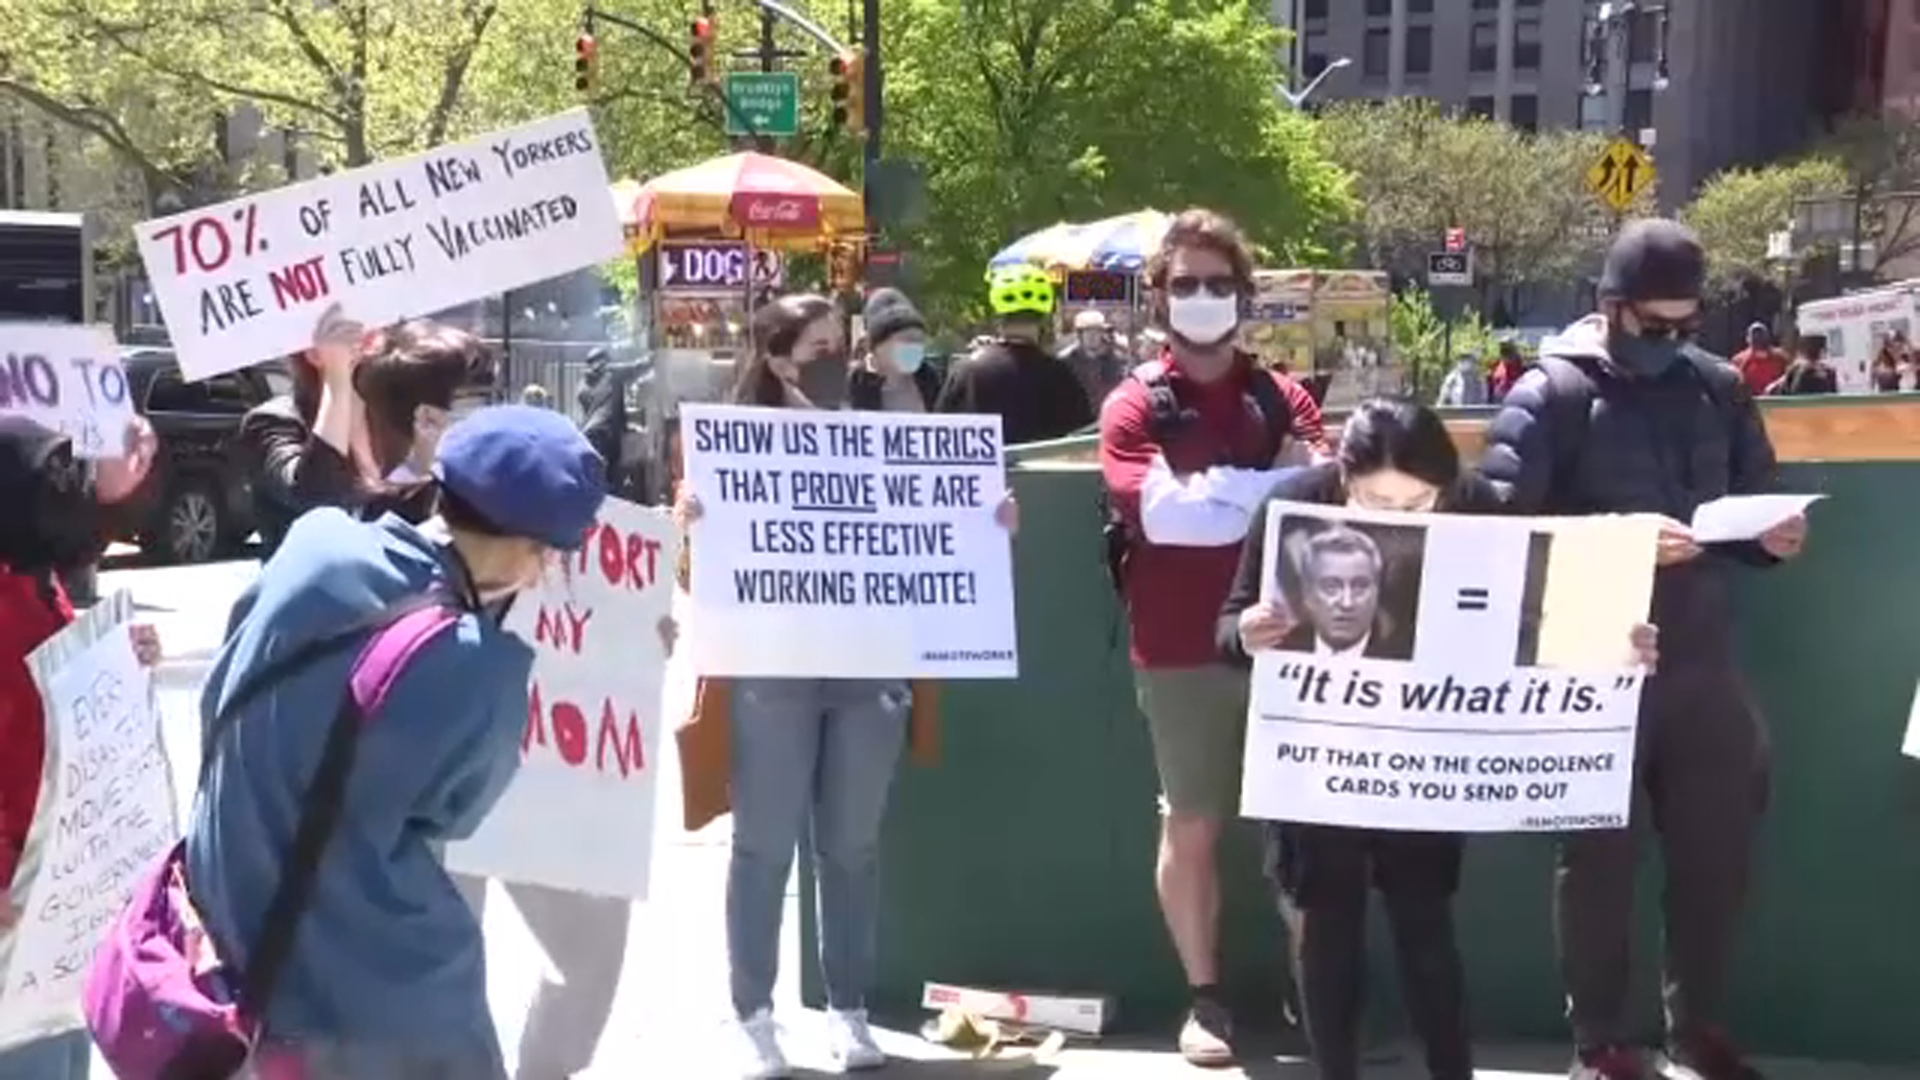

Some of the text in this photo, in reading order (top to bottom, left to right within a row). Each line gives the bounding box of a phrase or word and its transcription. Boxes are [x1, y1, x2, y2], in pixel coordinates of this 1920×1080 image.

[152, 128, 592, 275] 70% OF ALL NEW YORKERS
[201, 195, 577, 335] ARE NOT FULLY VACCINATED
[684, 249, 744, 285] DOG
[70, 358, 124, 411] TO
[695, 419, 997, 460] SHOW US THE METRICS
[715, 468, 981, 508] THAT PROVE WE ARE
[751, 520, 955, 556] LESS EFFECTIVE
[734, 569, 976, 605] WORKING REMOTE!
[535, 601, 592, 654] MY
[1342, 670, 1383, 707] is
[1401, 676, 1511, 714] what
[1520, 677, 1550, 714] it
[1277, 744, 1614, 774] PUT THAT ON THE CONDOLENCE
[1326, 776, 1568, 801] CARDS YOU SEND OUT
